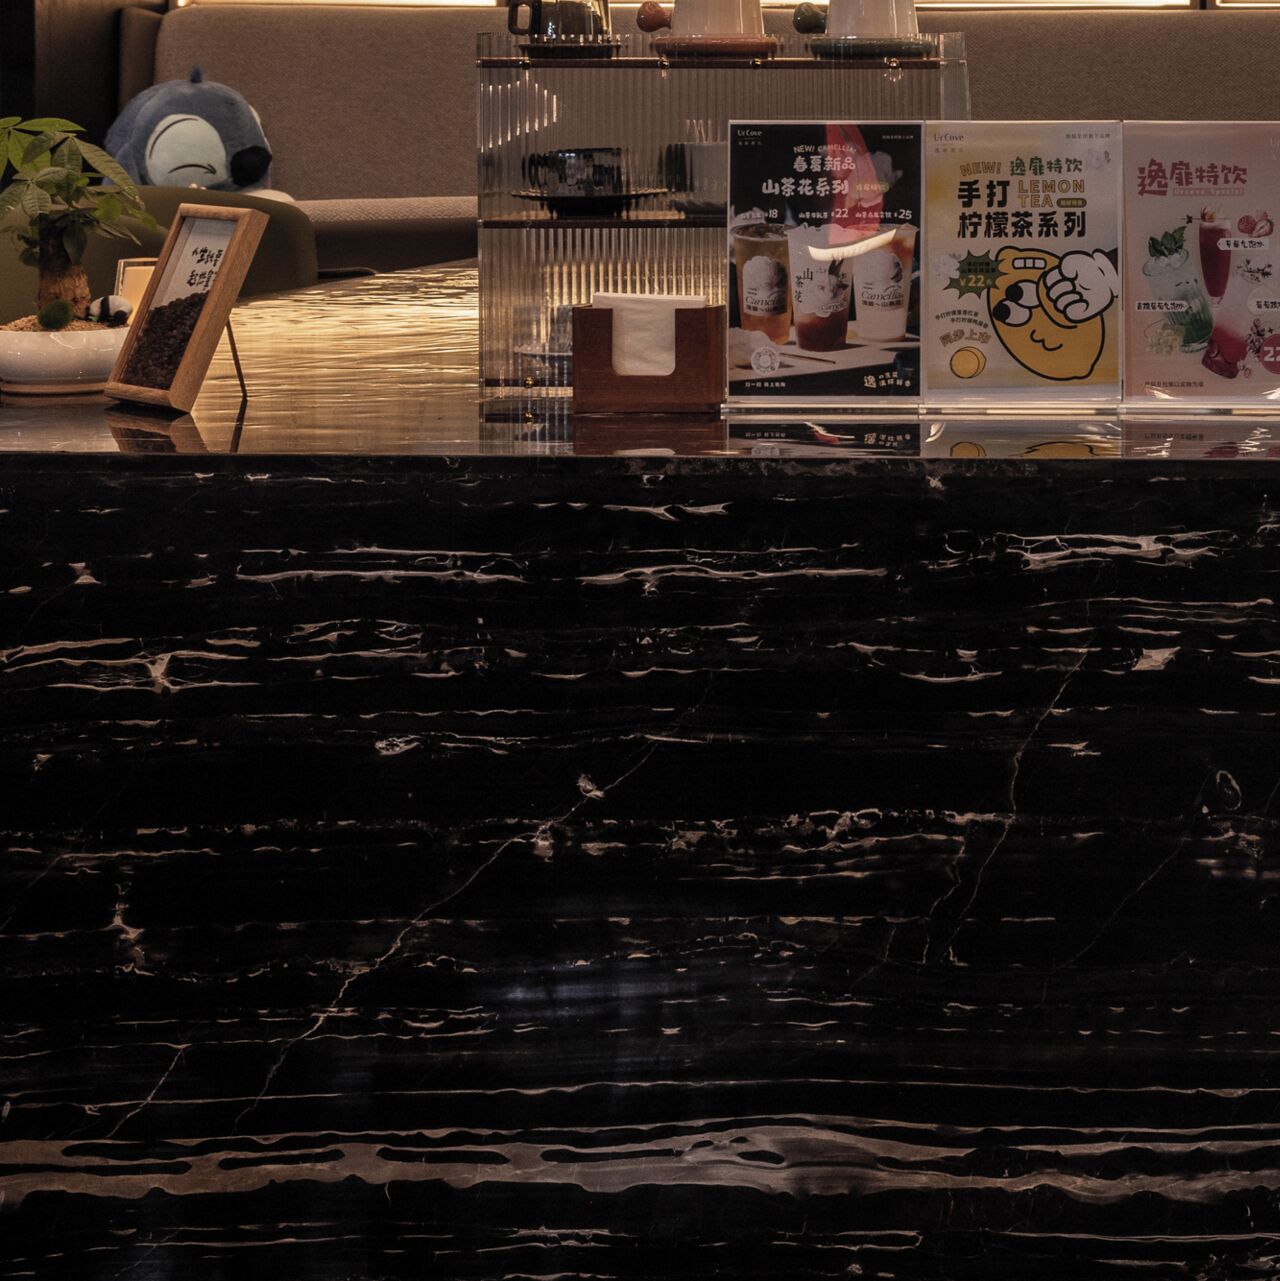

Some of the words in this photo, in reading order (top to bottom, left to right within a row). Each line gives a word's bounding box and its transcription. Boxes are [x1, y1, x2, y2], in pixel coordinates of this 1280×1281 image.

[934, 134, 964, 142] UrCove
[794, 144, 815, 154] NEW!
[793, 155, 856, 172] 春夏新品
[960, 161, 1002, 177] NEW!
[1009, 156, 1083, 176] 逸扉特饮
[1138, 158, 1248, 197] 逸扉特饮
[762, 177, 850, 197] 山茶花系列
[958, 180, 1010, 208] 手打
[1018, 179, 1085, 194] LEMON
[1018, 194, 1054, 208] TEA
[958, 211, 1086, 238] 柠檬茶系列
